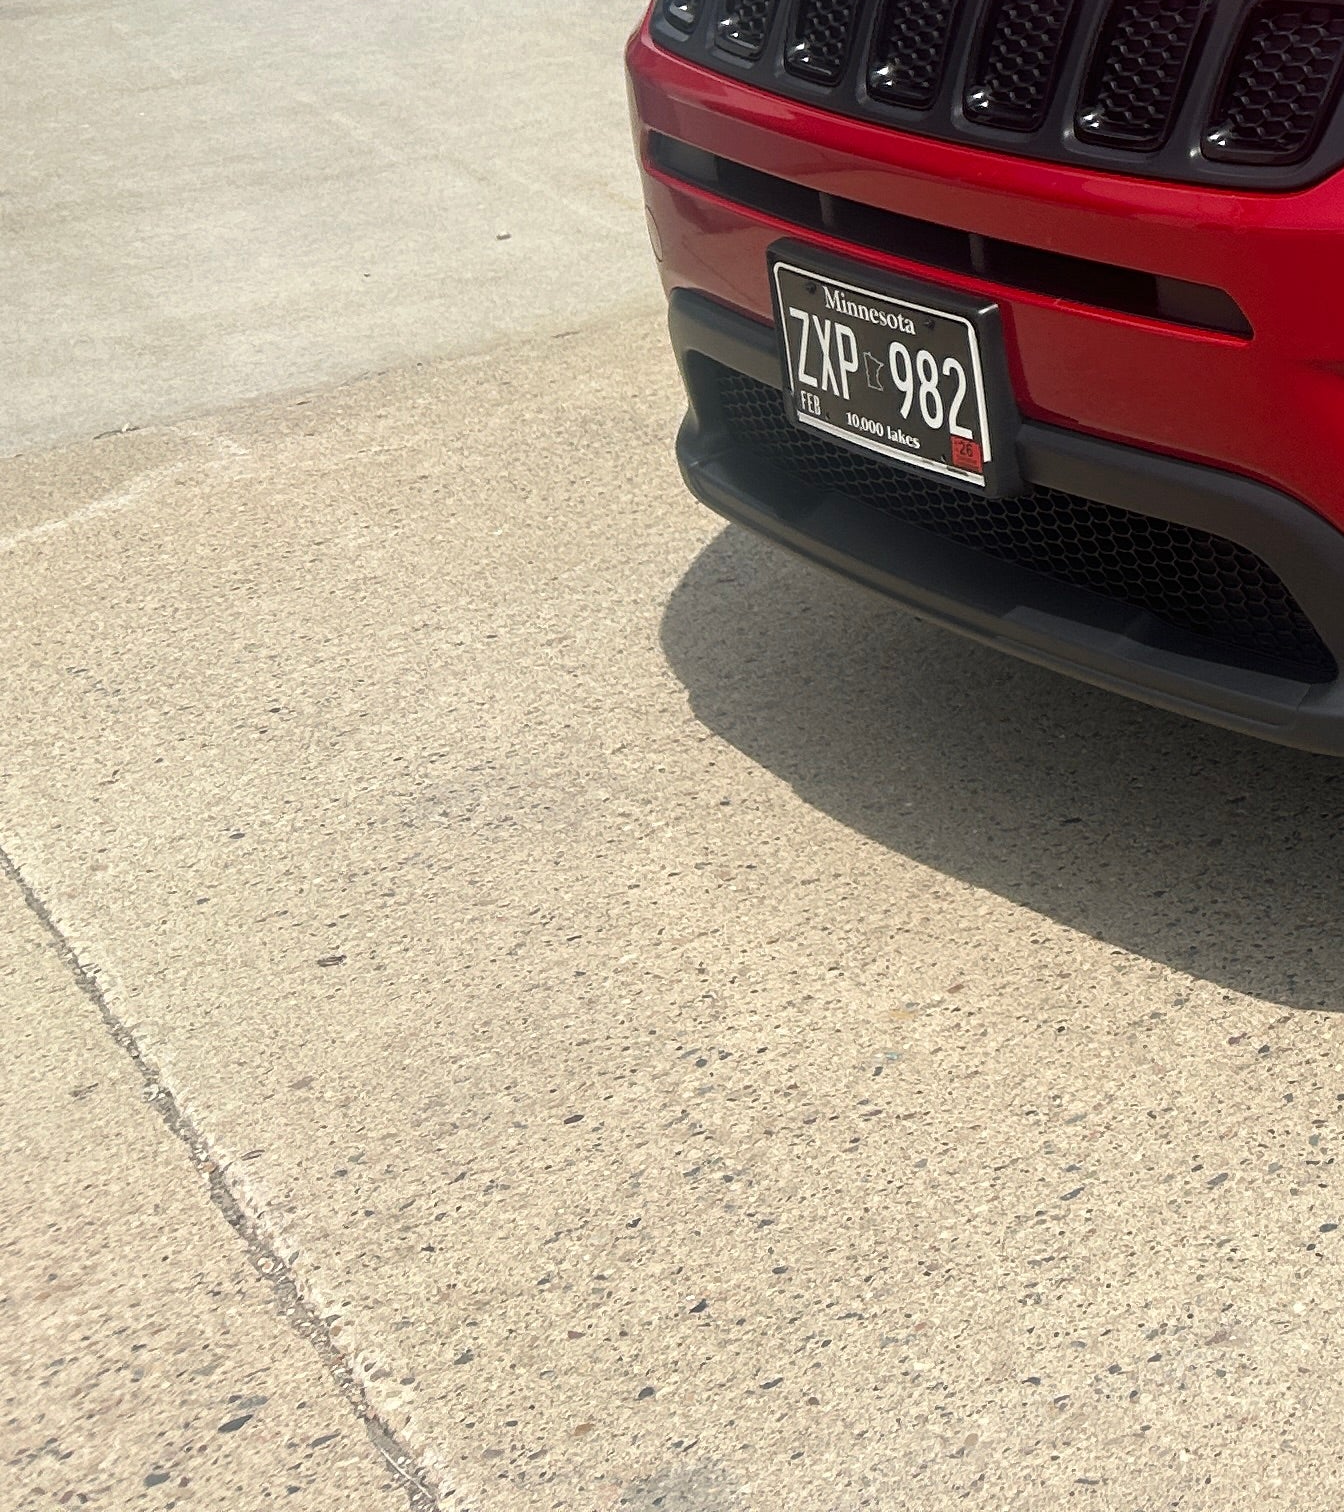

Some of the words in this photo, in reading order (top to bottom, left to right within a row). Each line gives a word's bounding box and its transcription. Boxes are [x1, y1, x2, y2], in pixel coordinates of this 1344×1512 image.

[822, 285, 917, 335] Minnesota
[789, 306, 859, 401] ZXP
[889, 341, 974, 439] 982
[800, 390, 822, 416] FEB
[846, 411, 884, 437] 10,000
[887, 425, 921, 450] lakes
[959, 440, 974, 458] 26
